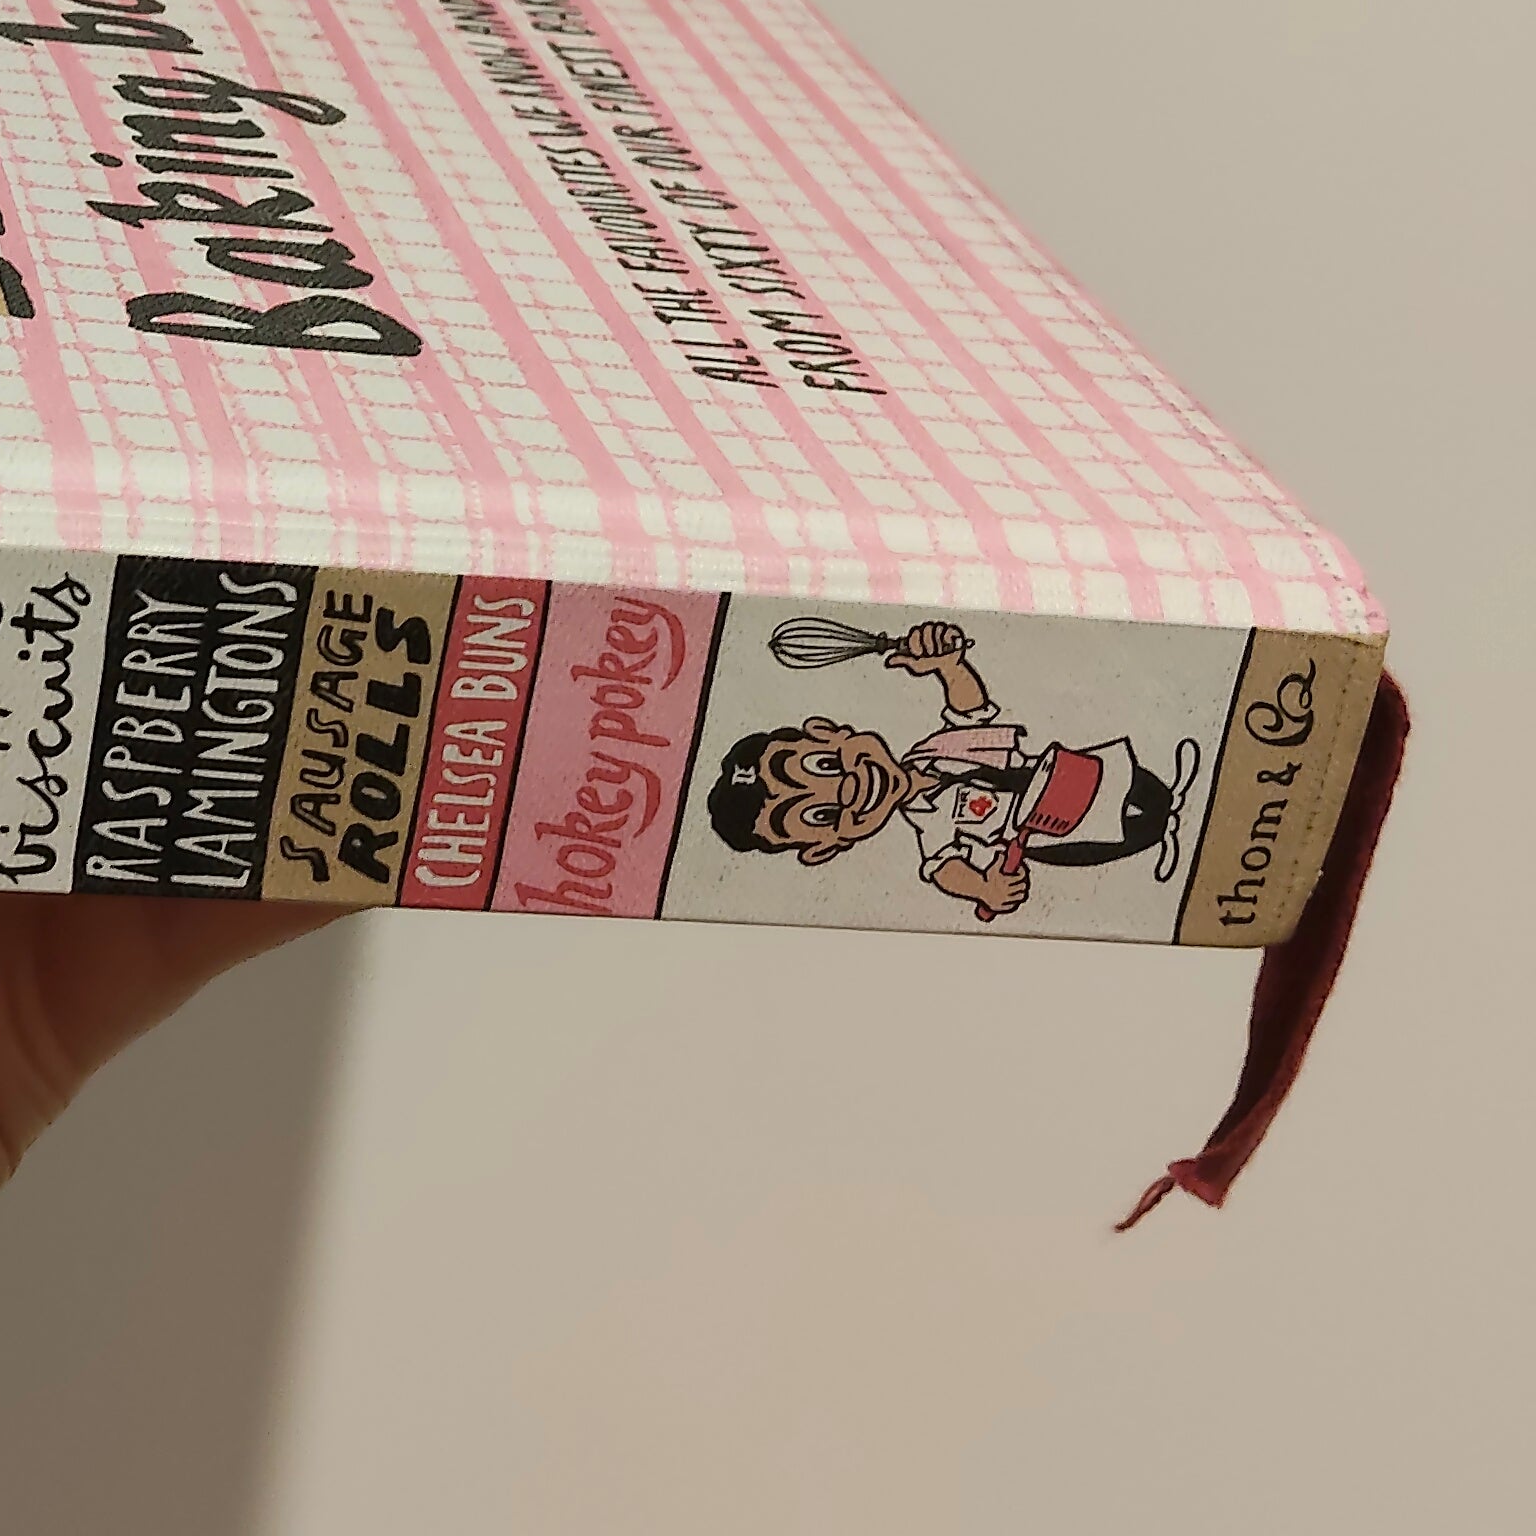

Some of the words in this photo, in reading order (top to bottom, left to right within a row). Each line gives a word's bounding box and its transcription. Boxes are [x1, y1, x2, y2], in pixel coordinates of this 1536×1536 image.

[467, 40, 564, 100] KNOW
[511, 104, 588, 136] WE
[547, 40, 663, 118] FINEST
[611, 125, 704, 172] OUR
[649, 177, 739, 210] OF
[86, 67, 424, 357] Baking
[537, 144, 690, 274] FAVOURITES
[680, 219, 806, 300] SIXTY
[632, 282, 727, 325] THE
[749, 309, 888, 396] FROM
[671, 337, 780, 389] ALL
[450, 594, 537, 701] BUNS
[571, 596, 686, 747] pokey
[85, 589, 209, 883] RASPBERRY
[170, 572, 299, 888] LAMINGTONS
[280, 589, 373, 883] SAUSAGE
[337, 606, 432, 884] ROLLS
[414, 720, 509, 888] CHELSEA
[514, 751, 661, 913] hokey
[1217, 799, 1288, 927] thom
[1256, 761, 1303, 787] &
